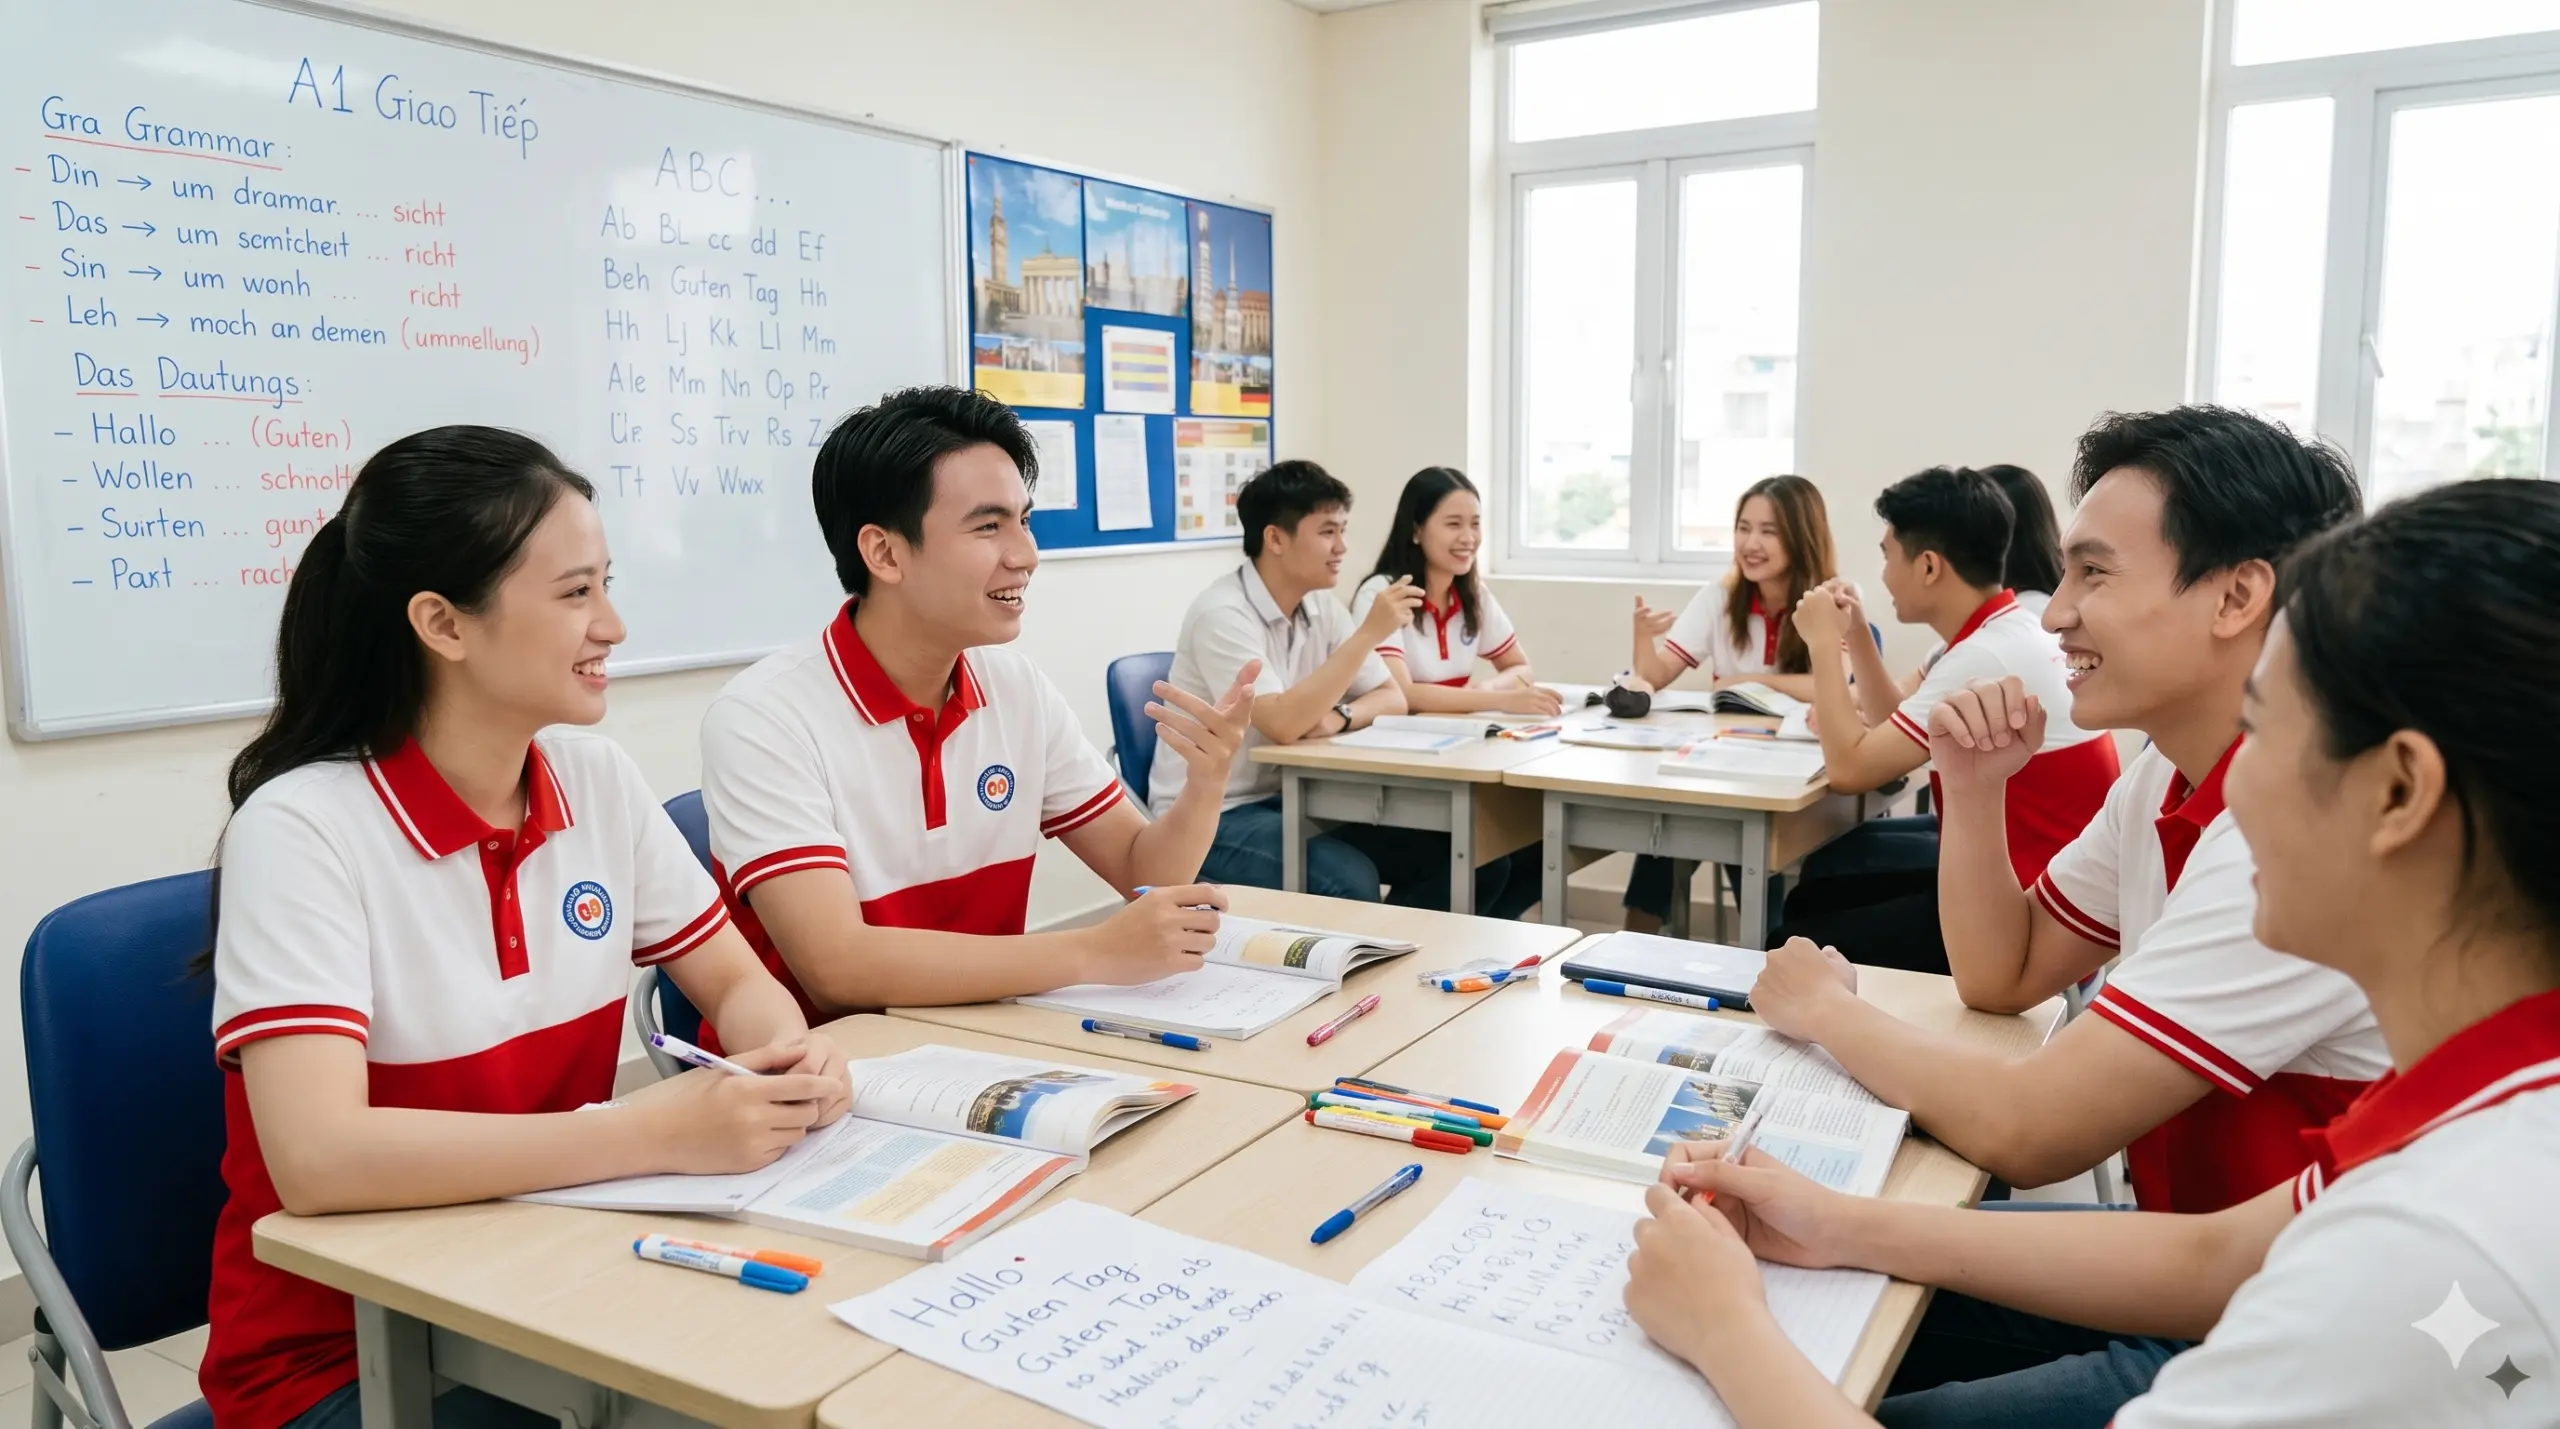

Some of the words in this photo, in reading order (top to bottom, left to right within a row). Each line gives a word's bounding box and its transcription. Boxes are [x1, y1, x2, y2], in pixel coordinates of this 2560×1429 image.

[41, 95, 104, 136] Gra
[288, 56, 353, 115] A1
[375, 73, 456, 129] Giao
[468, 89, 539, 160] Tiếp
[47, 152, 100, 188] Din
[172, 180, 214, 200] um
[393, 199, 446, 226] sicht
[52, 199, 108, 234] Das
[176, 227, 219, 246] um
[405, 241, 457, 268] richt
[601, 204, 636, 239] Ab
[751, 227, 776, 256] dd
[799, 231, 826, 261] Ef
[60, 248, 107, 279] Sin
[184, 271, 224, 289] um
[242, 269, 311, 297] wonh
[410, 282, 462, 309] richt
[604, 257, 650, 291] Beh
[671, 265, 731, 298] Guten
[743, 273, 778, 316] Tag
[801, 278, 827, 306] Hh
[66, 295, 117, 327] Leh
[190, 308, 256, 337] moch
[272, 323, 300, 339] an
[312, 315, 386, 344] demen
[606, 309, 640, 342] Hh
[710, 317, 738, 347] Kk
[803, 325, 836, 354] Mm
[73, 351, 134, 388] Das
[669, 366, 705, 394] Mm
[722, 368, 750, 397] Nn
[766, 369, 795, 411] Op
[92, 412, 176, 446] Hallo
[251, 416, 352, 452] (Guten)
[671, 412, 698, 446] Ss
[768, 417, 792, 447] Rs
[92, 460, 193, 490] Wollen
[672, 466, 700, 495] Vv
[717, 466, 764, 495] Wwx
[890, 1268, 1024, 1328] Hallo
[960, 1297, 1068, 1353] Guten
[1016, 1318, 1119, 1374] Guten
[1108, 1281, 1191, 1311] Tag
